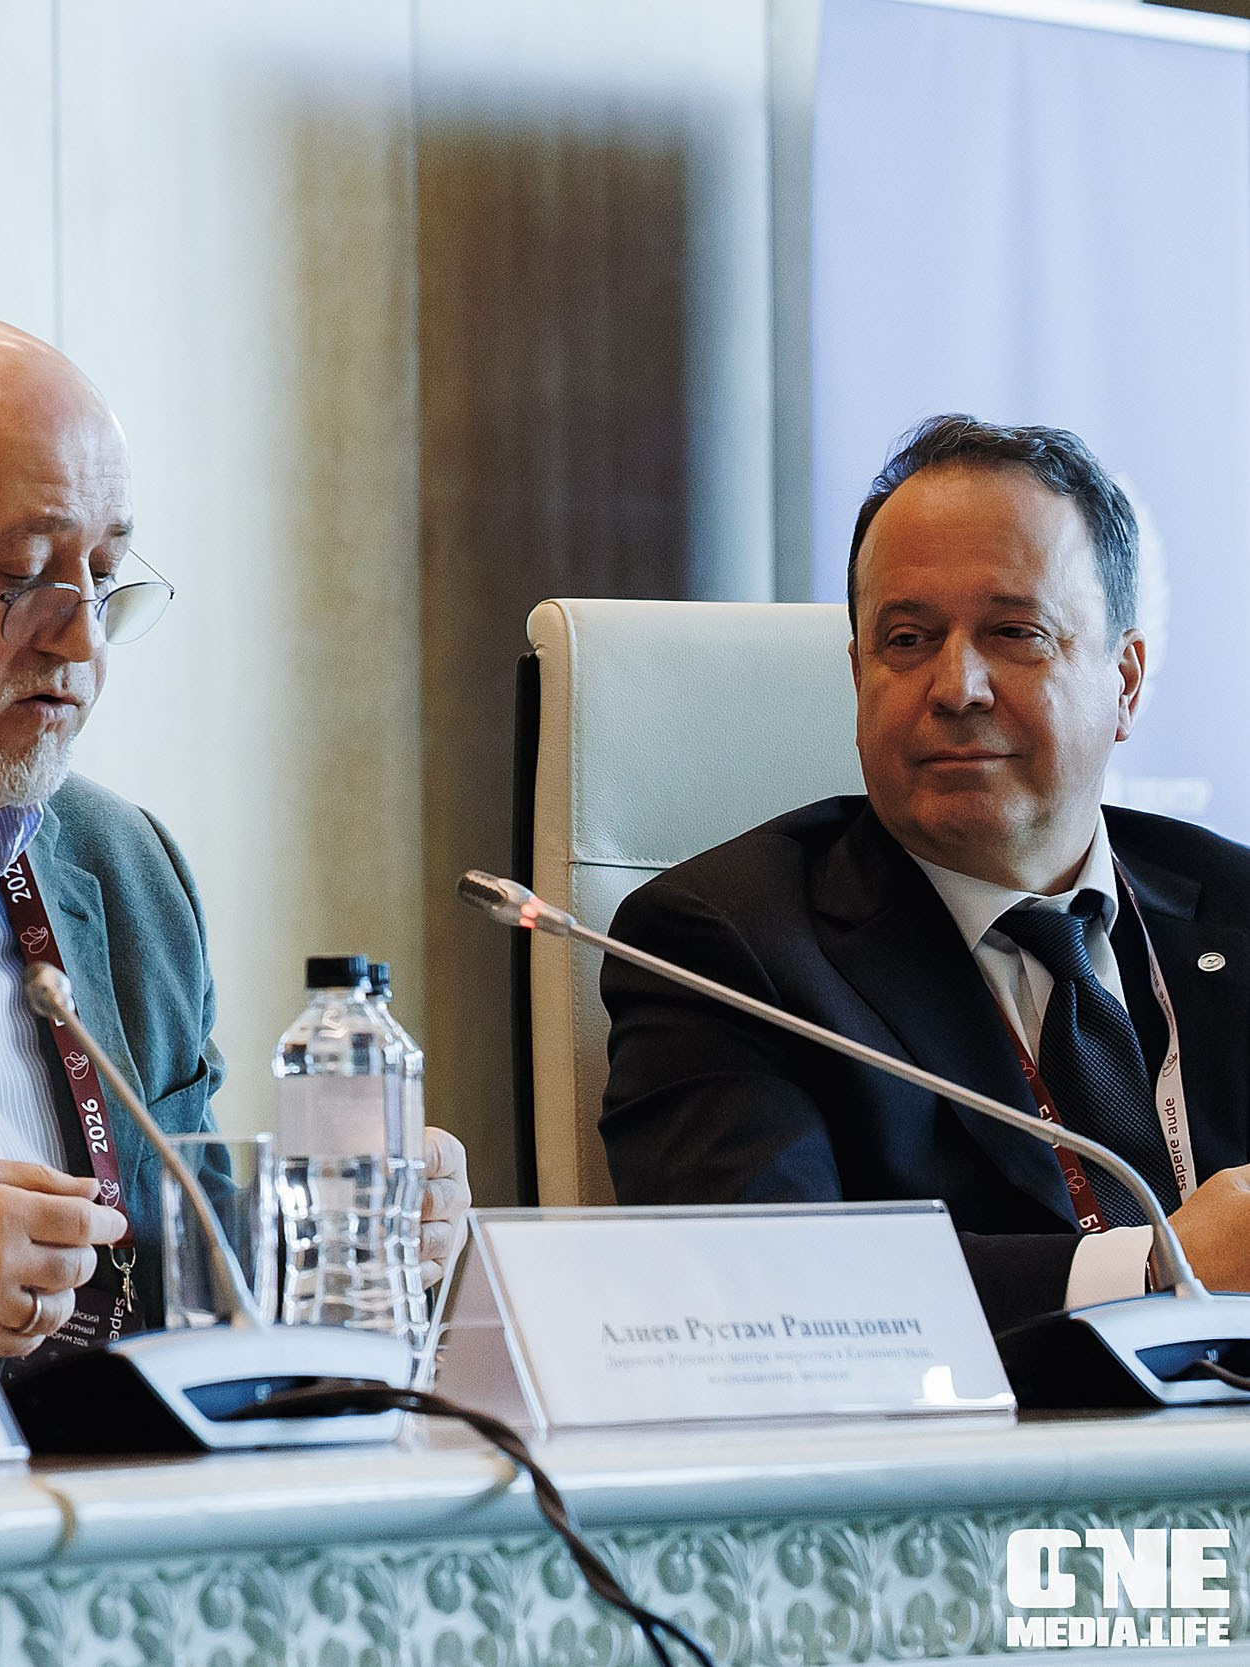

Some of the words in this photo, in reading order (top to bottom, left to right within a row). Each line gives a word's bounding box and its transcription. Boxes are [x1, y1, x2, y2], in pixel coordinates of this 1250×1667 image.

[3, 863, 32, 903] 202
[81, 1098, 107, 1154] 2026
[1164, 1097, 1178, 1135] aude
[1170, 1139, 1188, 1192] sapere
[62, 1321, 96, 1336] ТУРНЫЙ
[73, 1309, 100, 1323] ЙСКИЙ
[109, 1297, 125, 1341] sape
[601, 1322, 679, 1344] Алиев
[684, 1316, 775, 1347] Рустам
[781, 1313, 923, 1339] Рашидович
[48, 1331, 73, 1343] ОРУМ
